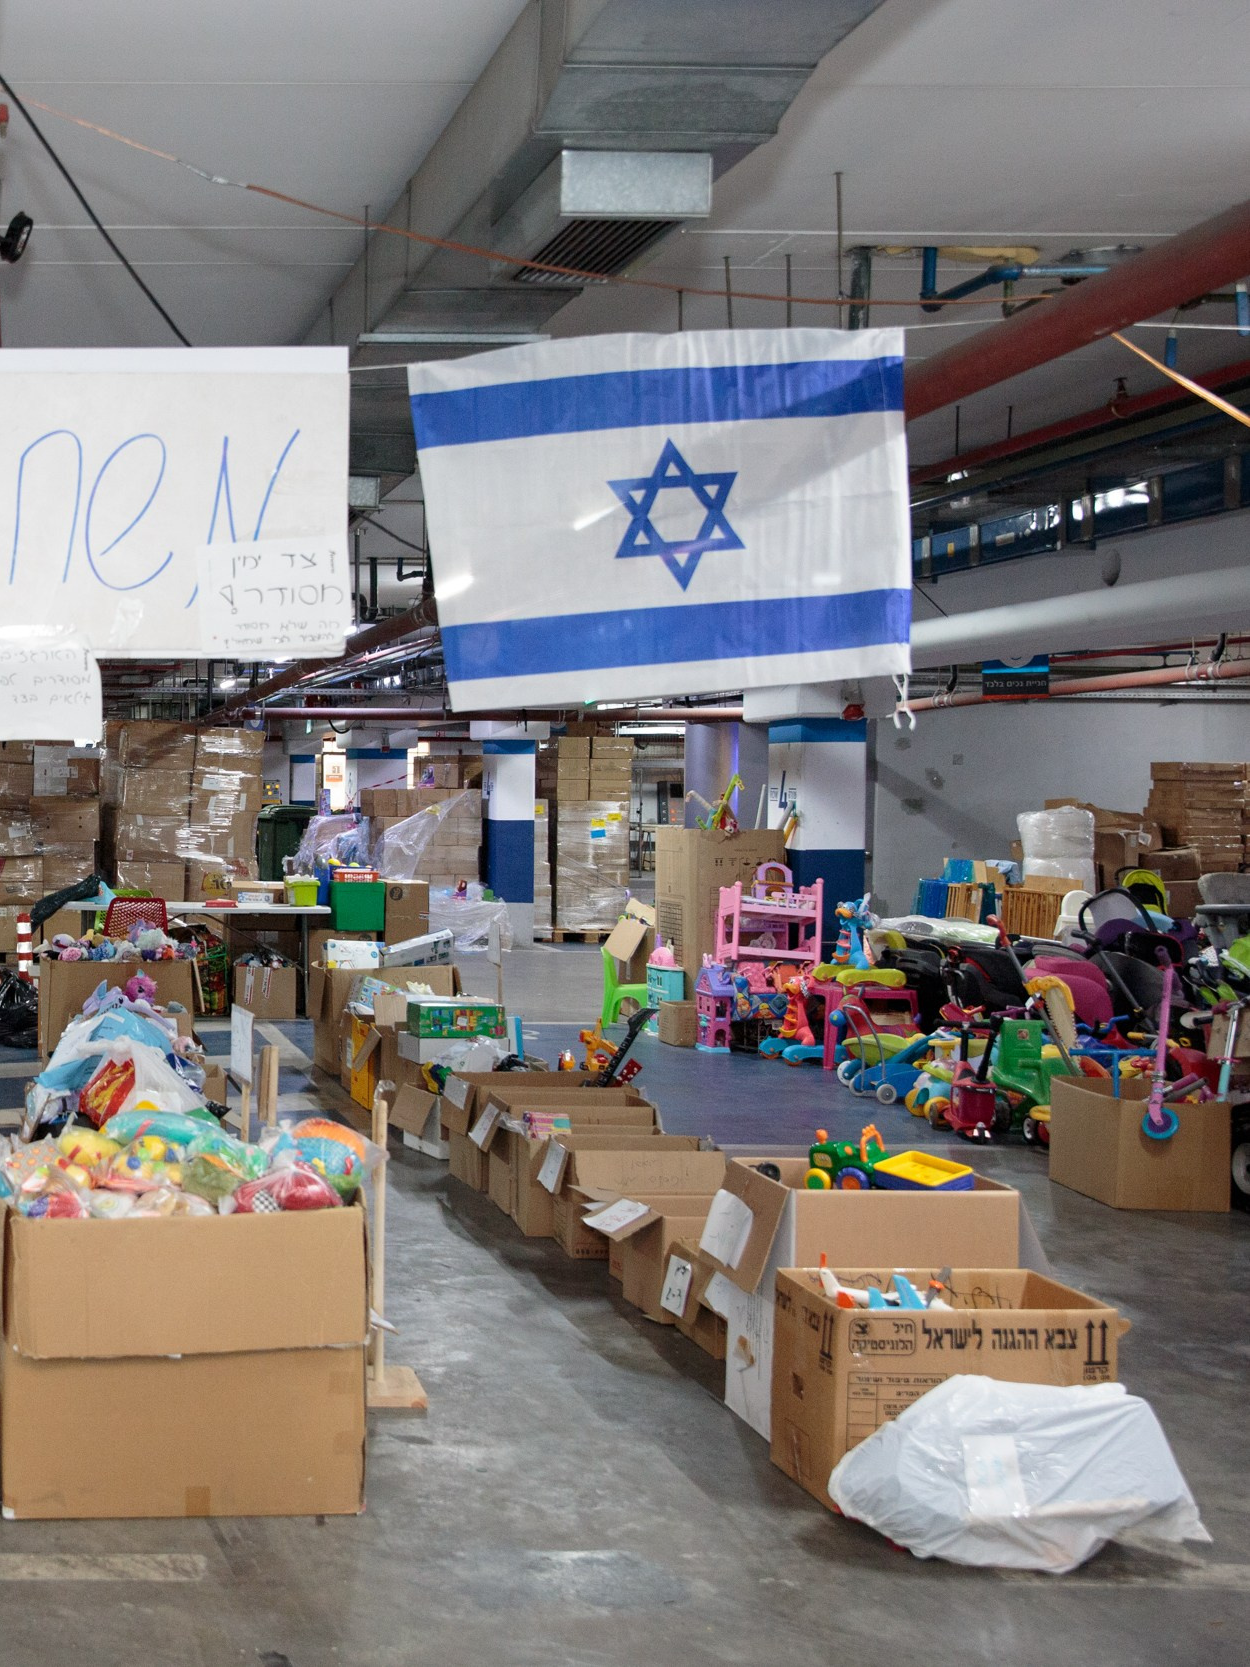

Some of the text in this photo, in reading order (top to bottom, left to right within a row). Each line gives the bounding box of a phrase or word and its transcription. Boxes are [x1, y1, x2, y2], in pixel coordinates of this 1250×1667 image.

[232, 555, 262, 579] ימין
[280, 553, 317, 569] צד
[892, 1321, 913, 1334] חיל
[921, 1318, 1078, 1351] צבא ההגנה לישראל
